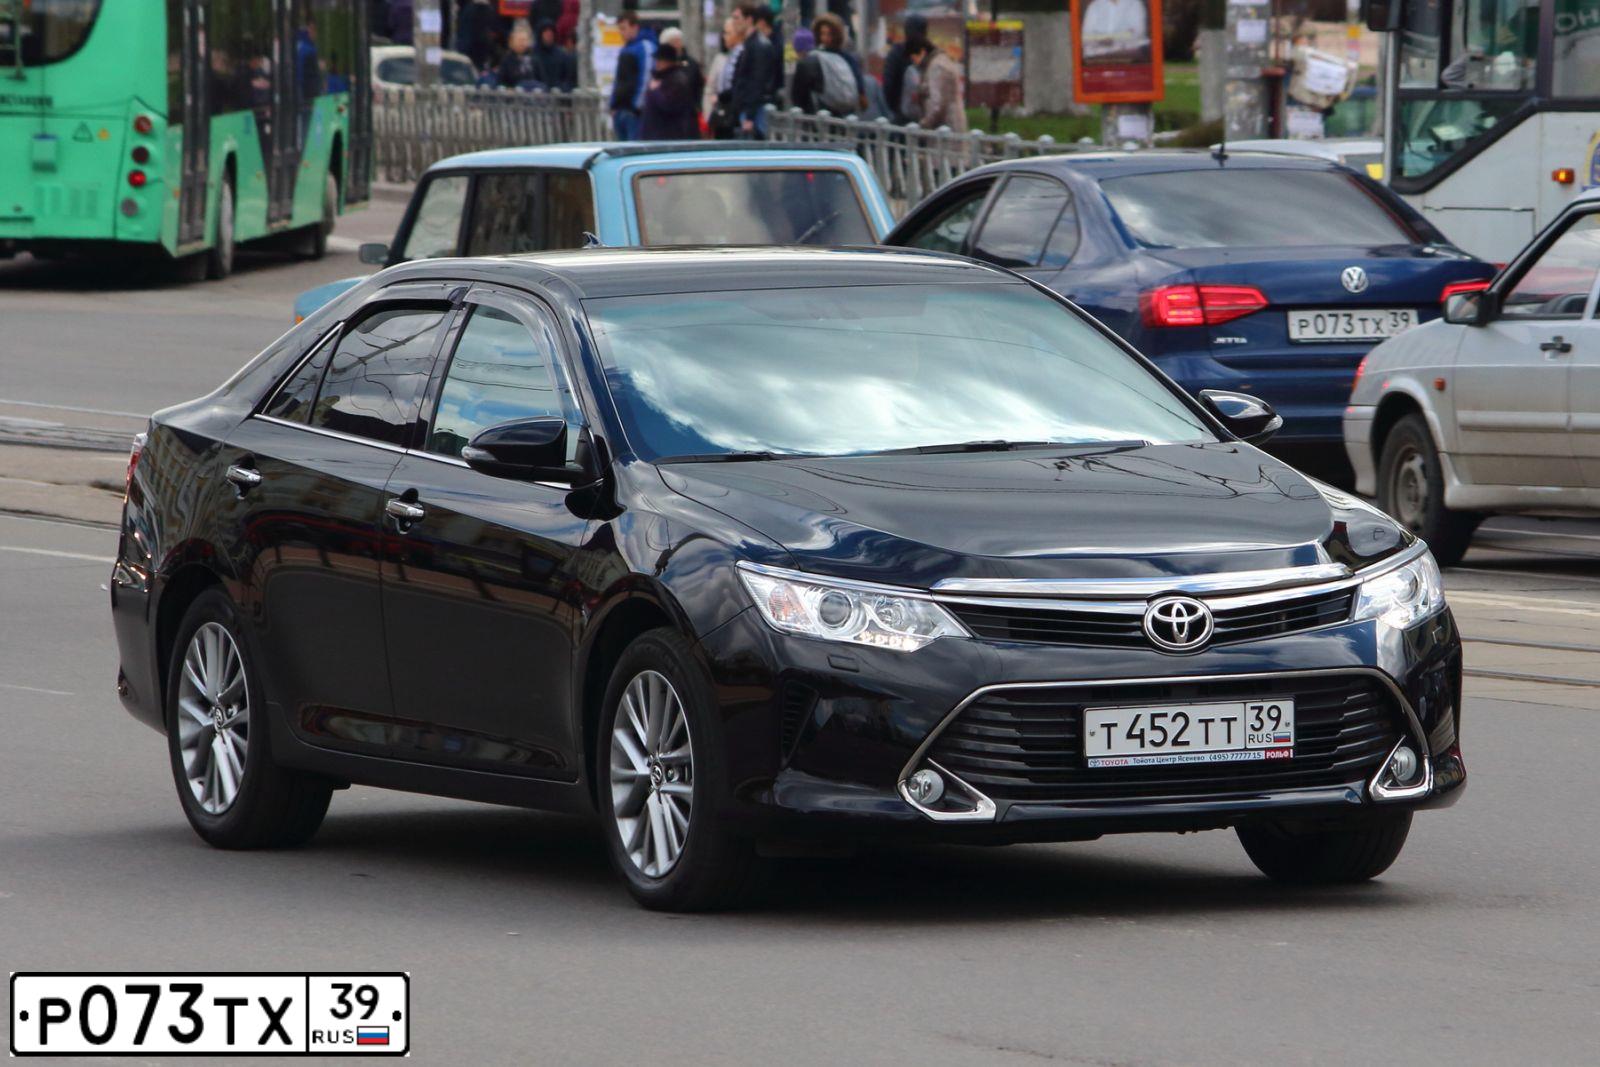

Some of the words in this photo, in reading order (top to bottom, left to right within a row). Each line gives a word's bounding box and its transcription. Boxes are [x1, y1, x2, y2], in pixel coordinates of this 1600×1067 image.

[1389, 312, 1411, 328] 39
[1249, 704, 1282, 732] 39
[1248, 733, 1273, 744] RUS
[1133, 757, 1155, 765] Тойота
[1156, 755, 1176, 764] Центр
[1209, 753, 1229, 761] (495)
[1266, 750, 1290, 759] РОЛЬФ
